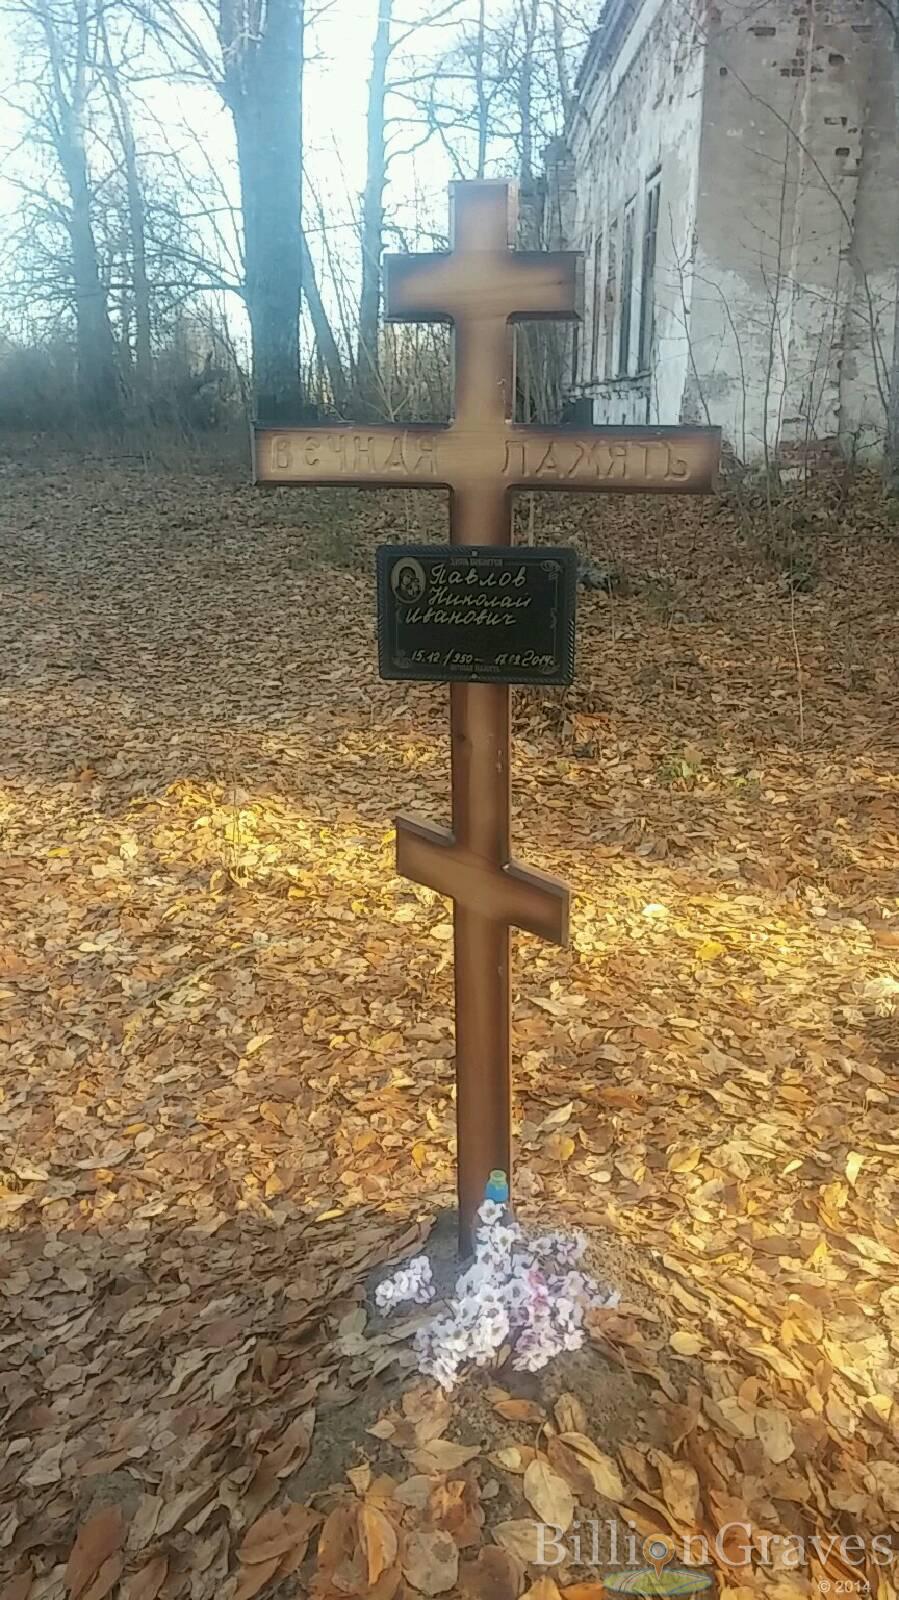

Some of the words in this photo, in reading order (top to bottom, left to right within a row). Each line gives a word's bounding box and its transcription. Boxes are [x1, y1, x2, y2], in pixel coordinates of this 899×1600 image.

[269, 435, 438, 475] ВЕЧНАЯ
[502, 440, 690, 482] ПАМЯТЬ
[430, 563, 527, 587] Павлов
[405, 607, 517, 626] Иванович
